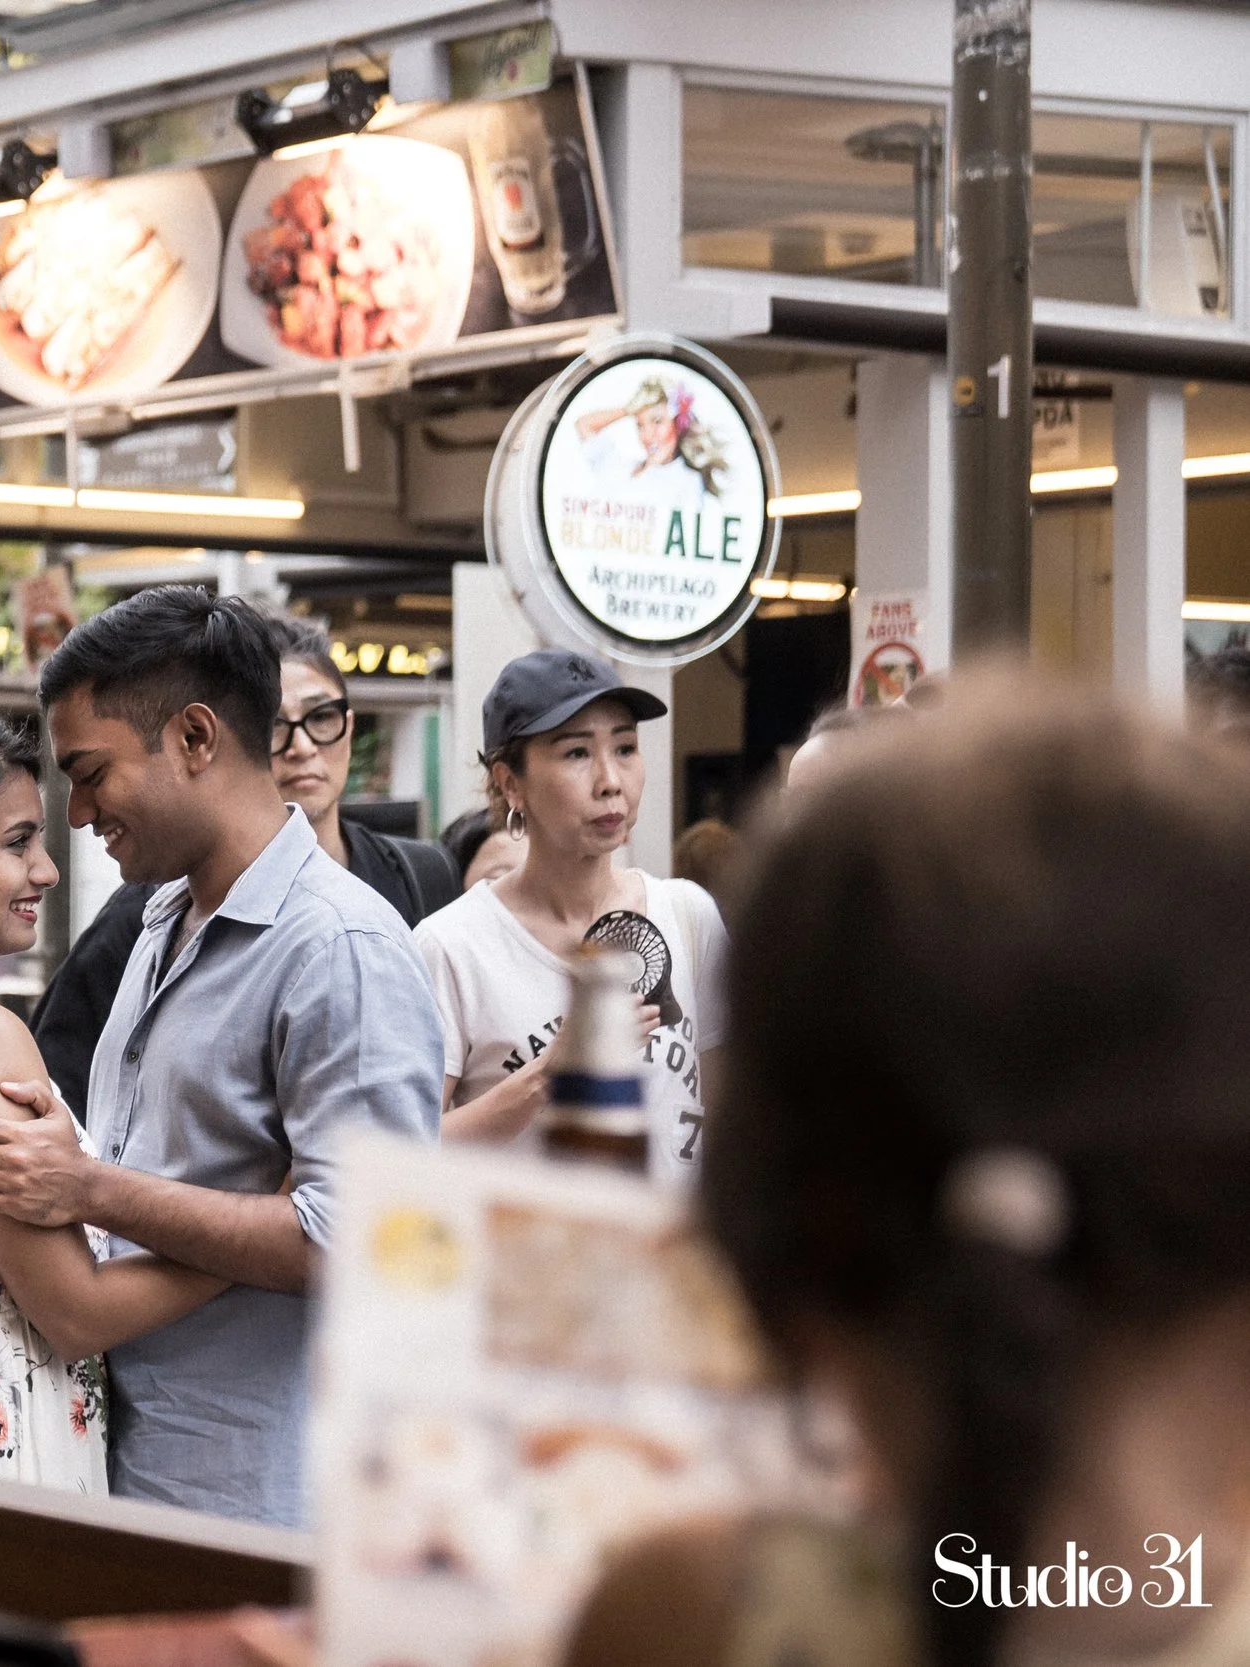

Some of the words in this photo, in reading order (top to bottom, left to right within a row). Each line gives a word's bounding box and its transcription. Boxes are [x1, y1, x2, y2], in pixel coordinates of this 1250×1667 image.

[986, 355, 1012, 419] 1
[560, 520, 657, 556] BLONDE
[663, 509, 742, 563] ALE
[588, 564, 716, 599] ARCHIPELAGO
[605, 593, 697, 623] BREWERY
[678, 1111, 704, 1161] 7
